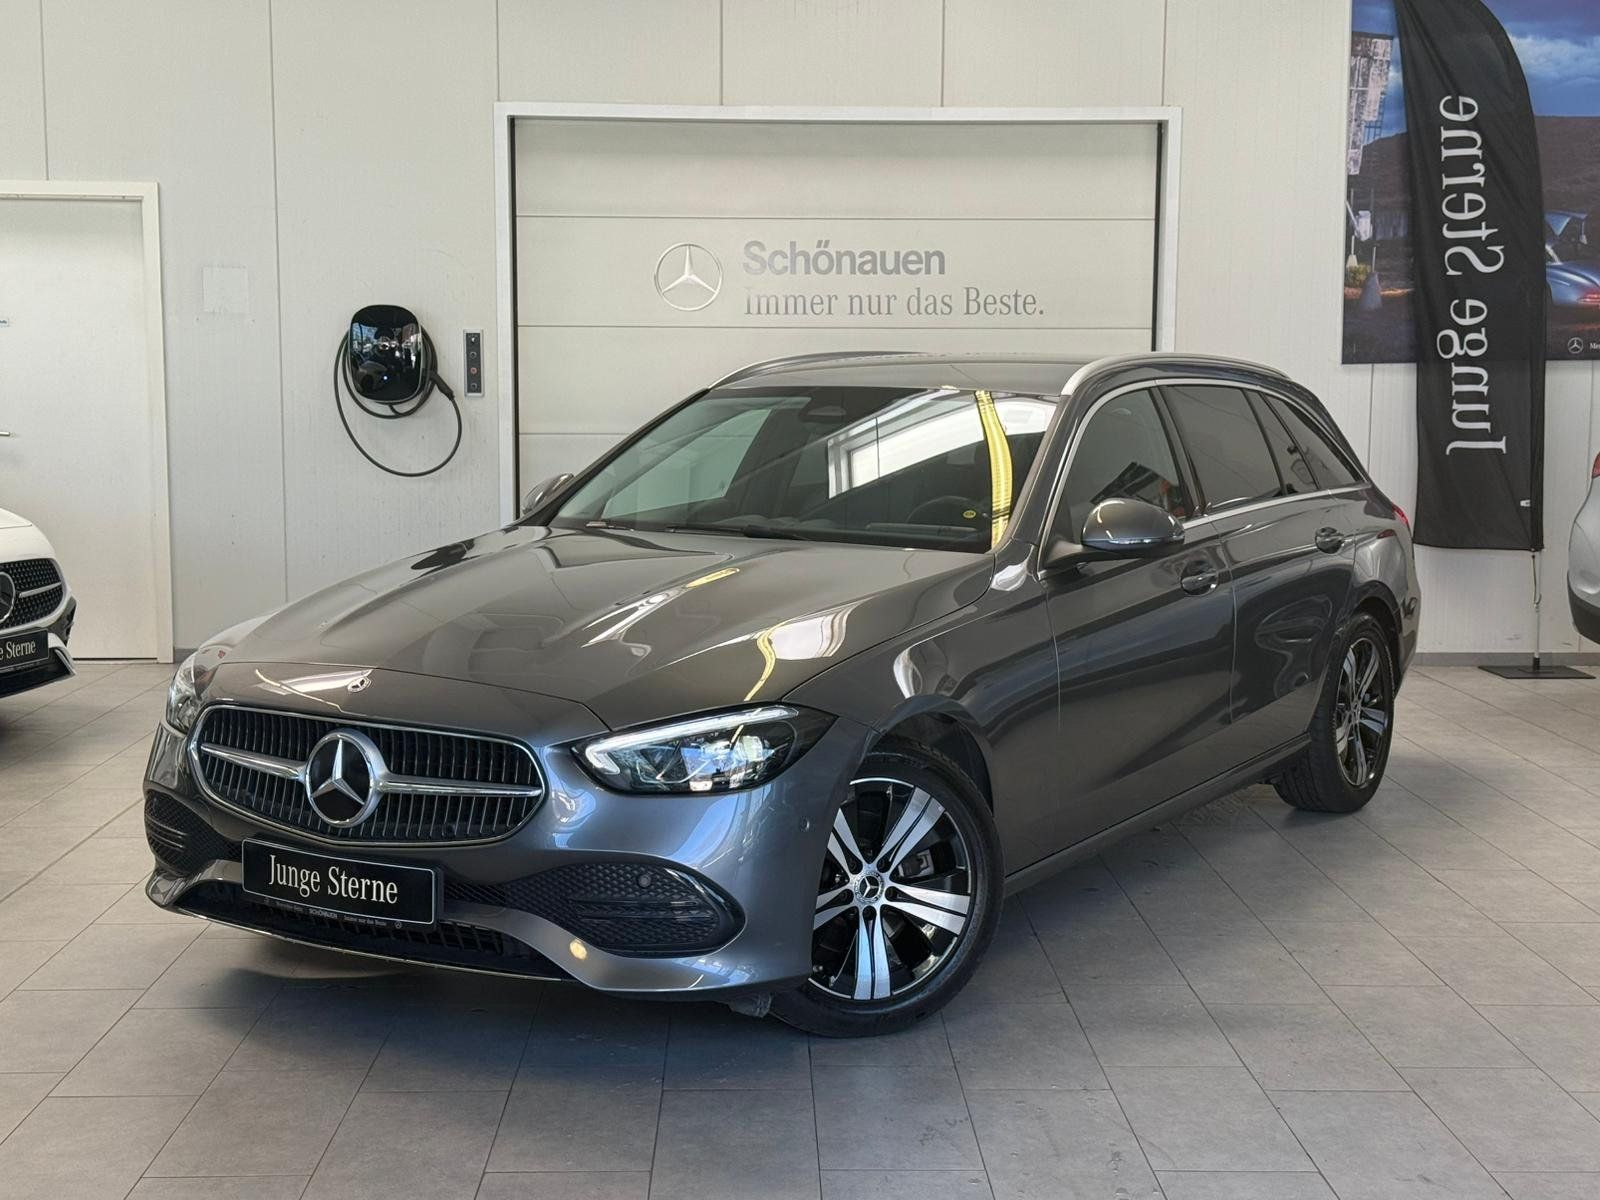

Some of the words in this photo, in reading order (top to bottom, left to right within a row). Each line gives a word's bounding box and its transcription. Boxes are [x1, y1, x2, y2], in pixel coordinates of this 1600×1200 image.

[743, 286, 838, 316] Immer
[848, 292, 898, 316] nur
[906, 286, 953, 316] das
[963, 286, 1044, 316] Beste.
[5, 640, 36, 659] Sterne
[268, 854, 321, 898] Junge
[327, 865, 399, 904] Sterne
